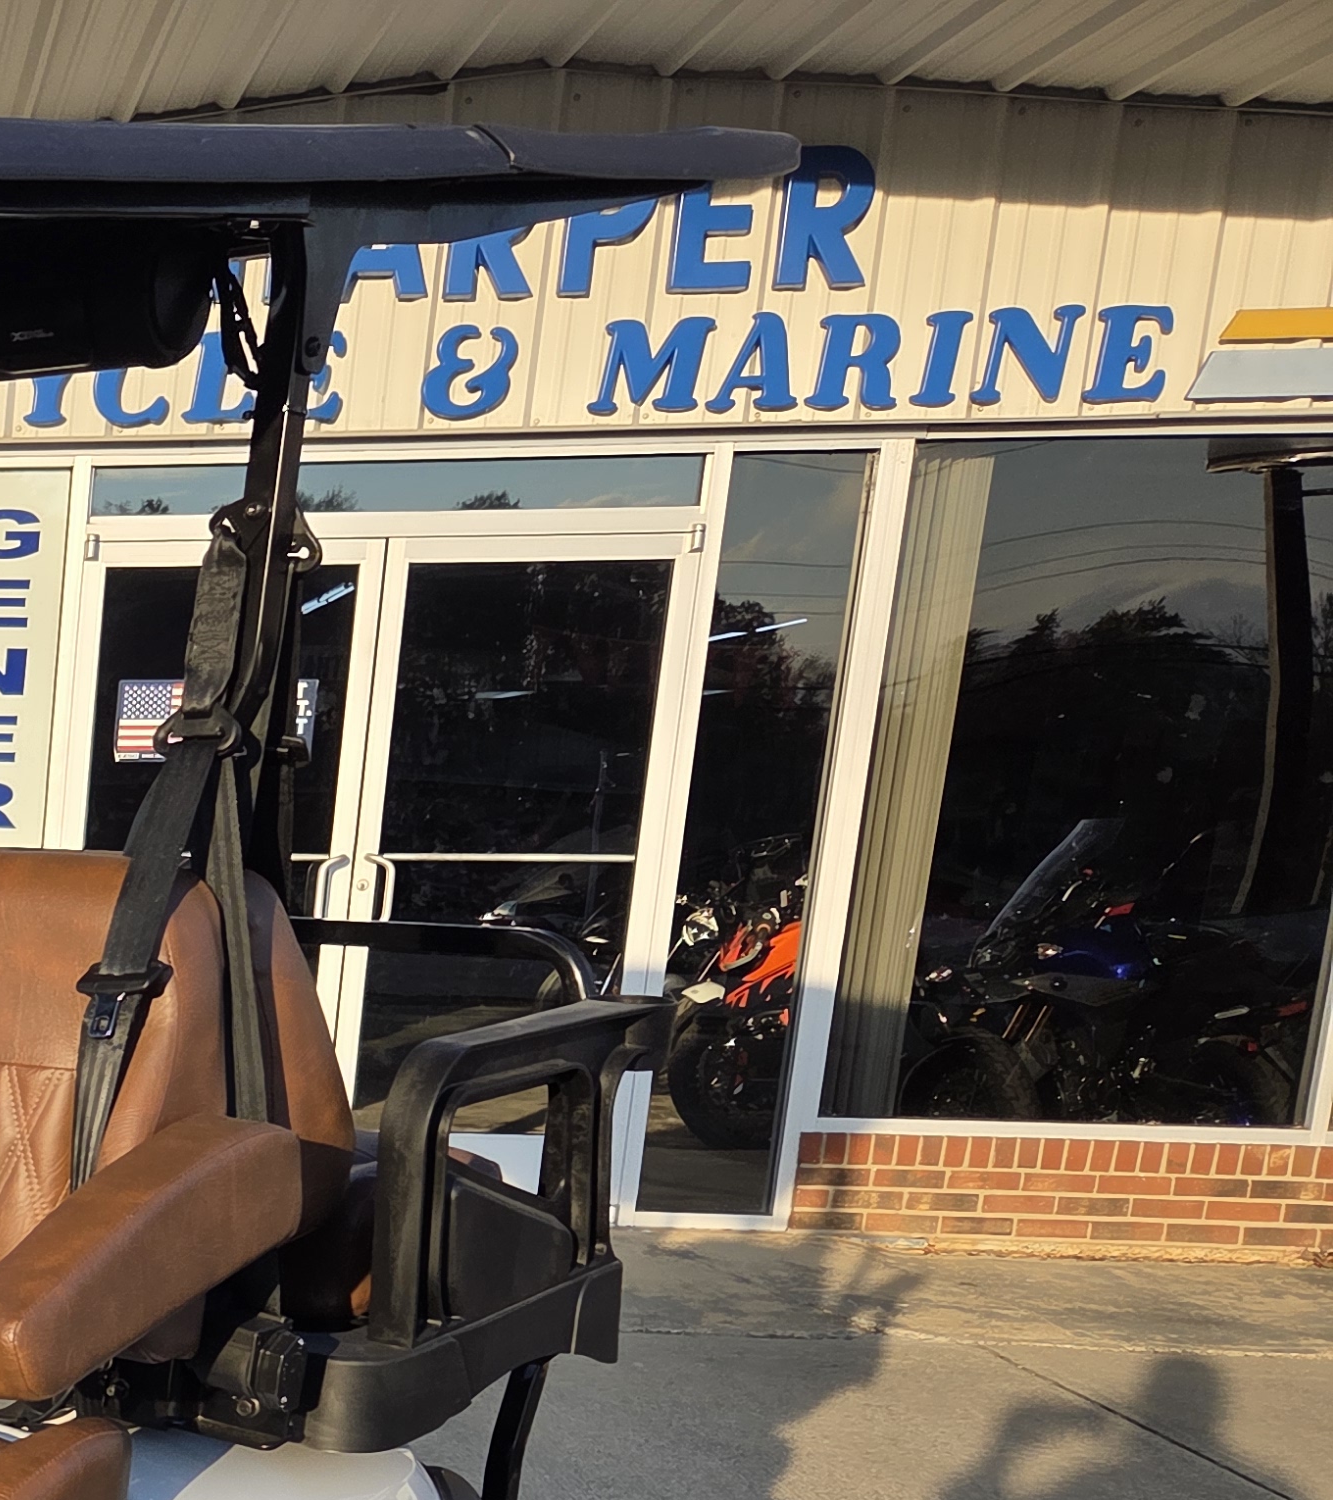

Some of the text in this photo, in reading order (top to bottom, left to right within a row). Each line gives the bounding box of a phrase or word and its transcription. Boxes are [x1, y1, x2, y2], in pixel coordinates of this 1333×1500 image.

[205, 145, 875, 302] ARPER
[421, 324, 519, 421] &
[586, 305, 1173, 416] MARINE
